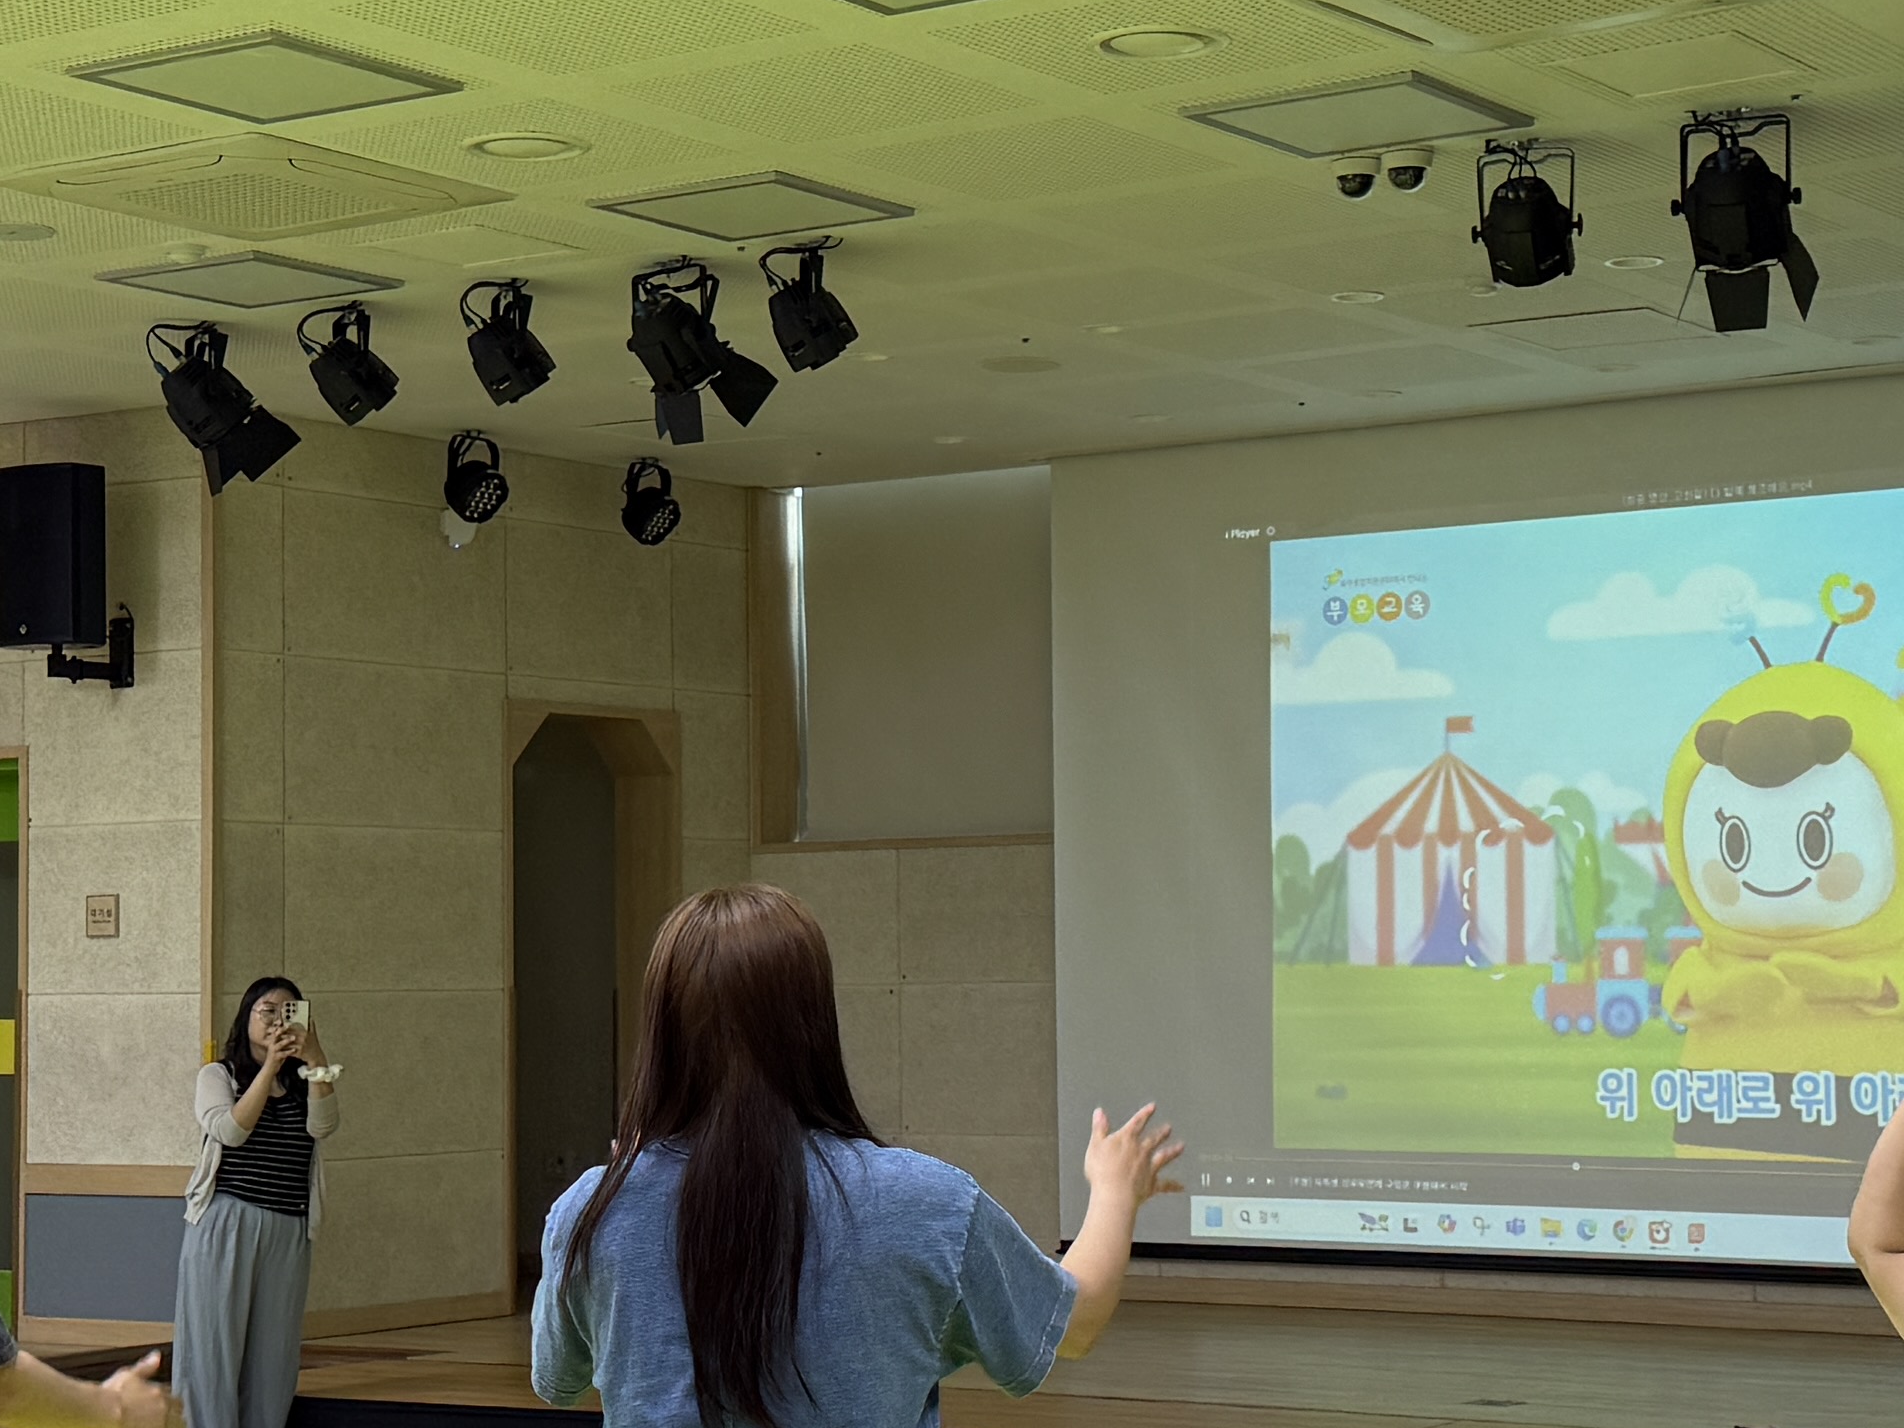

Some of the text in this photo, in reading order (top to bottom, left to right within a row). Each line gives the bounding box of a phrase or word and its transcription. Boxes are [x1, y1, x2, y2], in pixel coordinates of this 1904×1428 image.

[1325, 592, 1428, 623] 부모교육
[1596, 1067, 1638, 1123] 위
[1651, 1069, 1781, 1124] 아래로
[1791, 1071, 1838, 1126] 위
